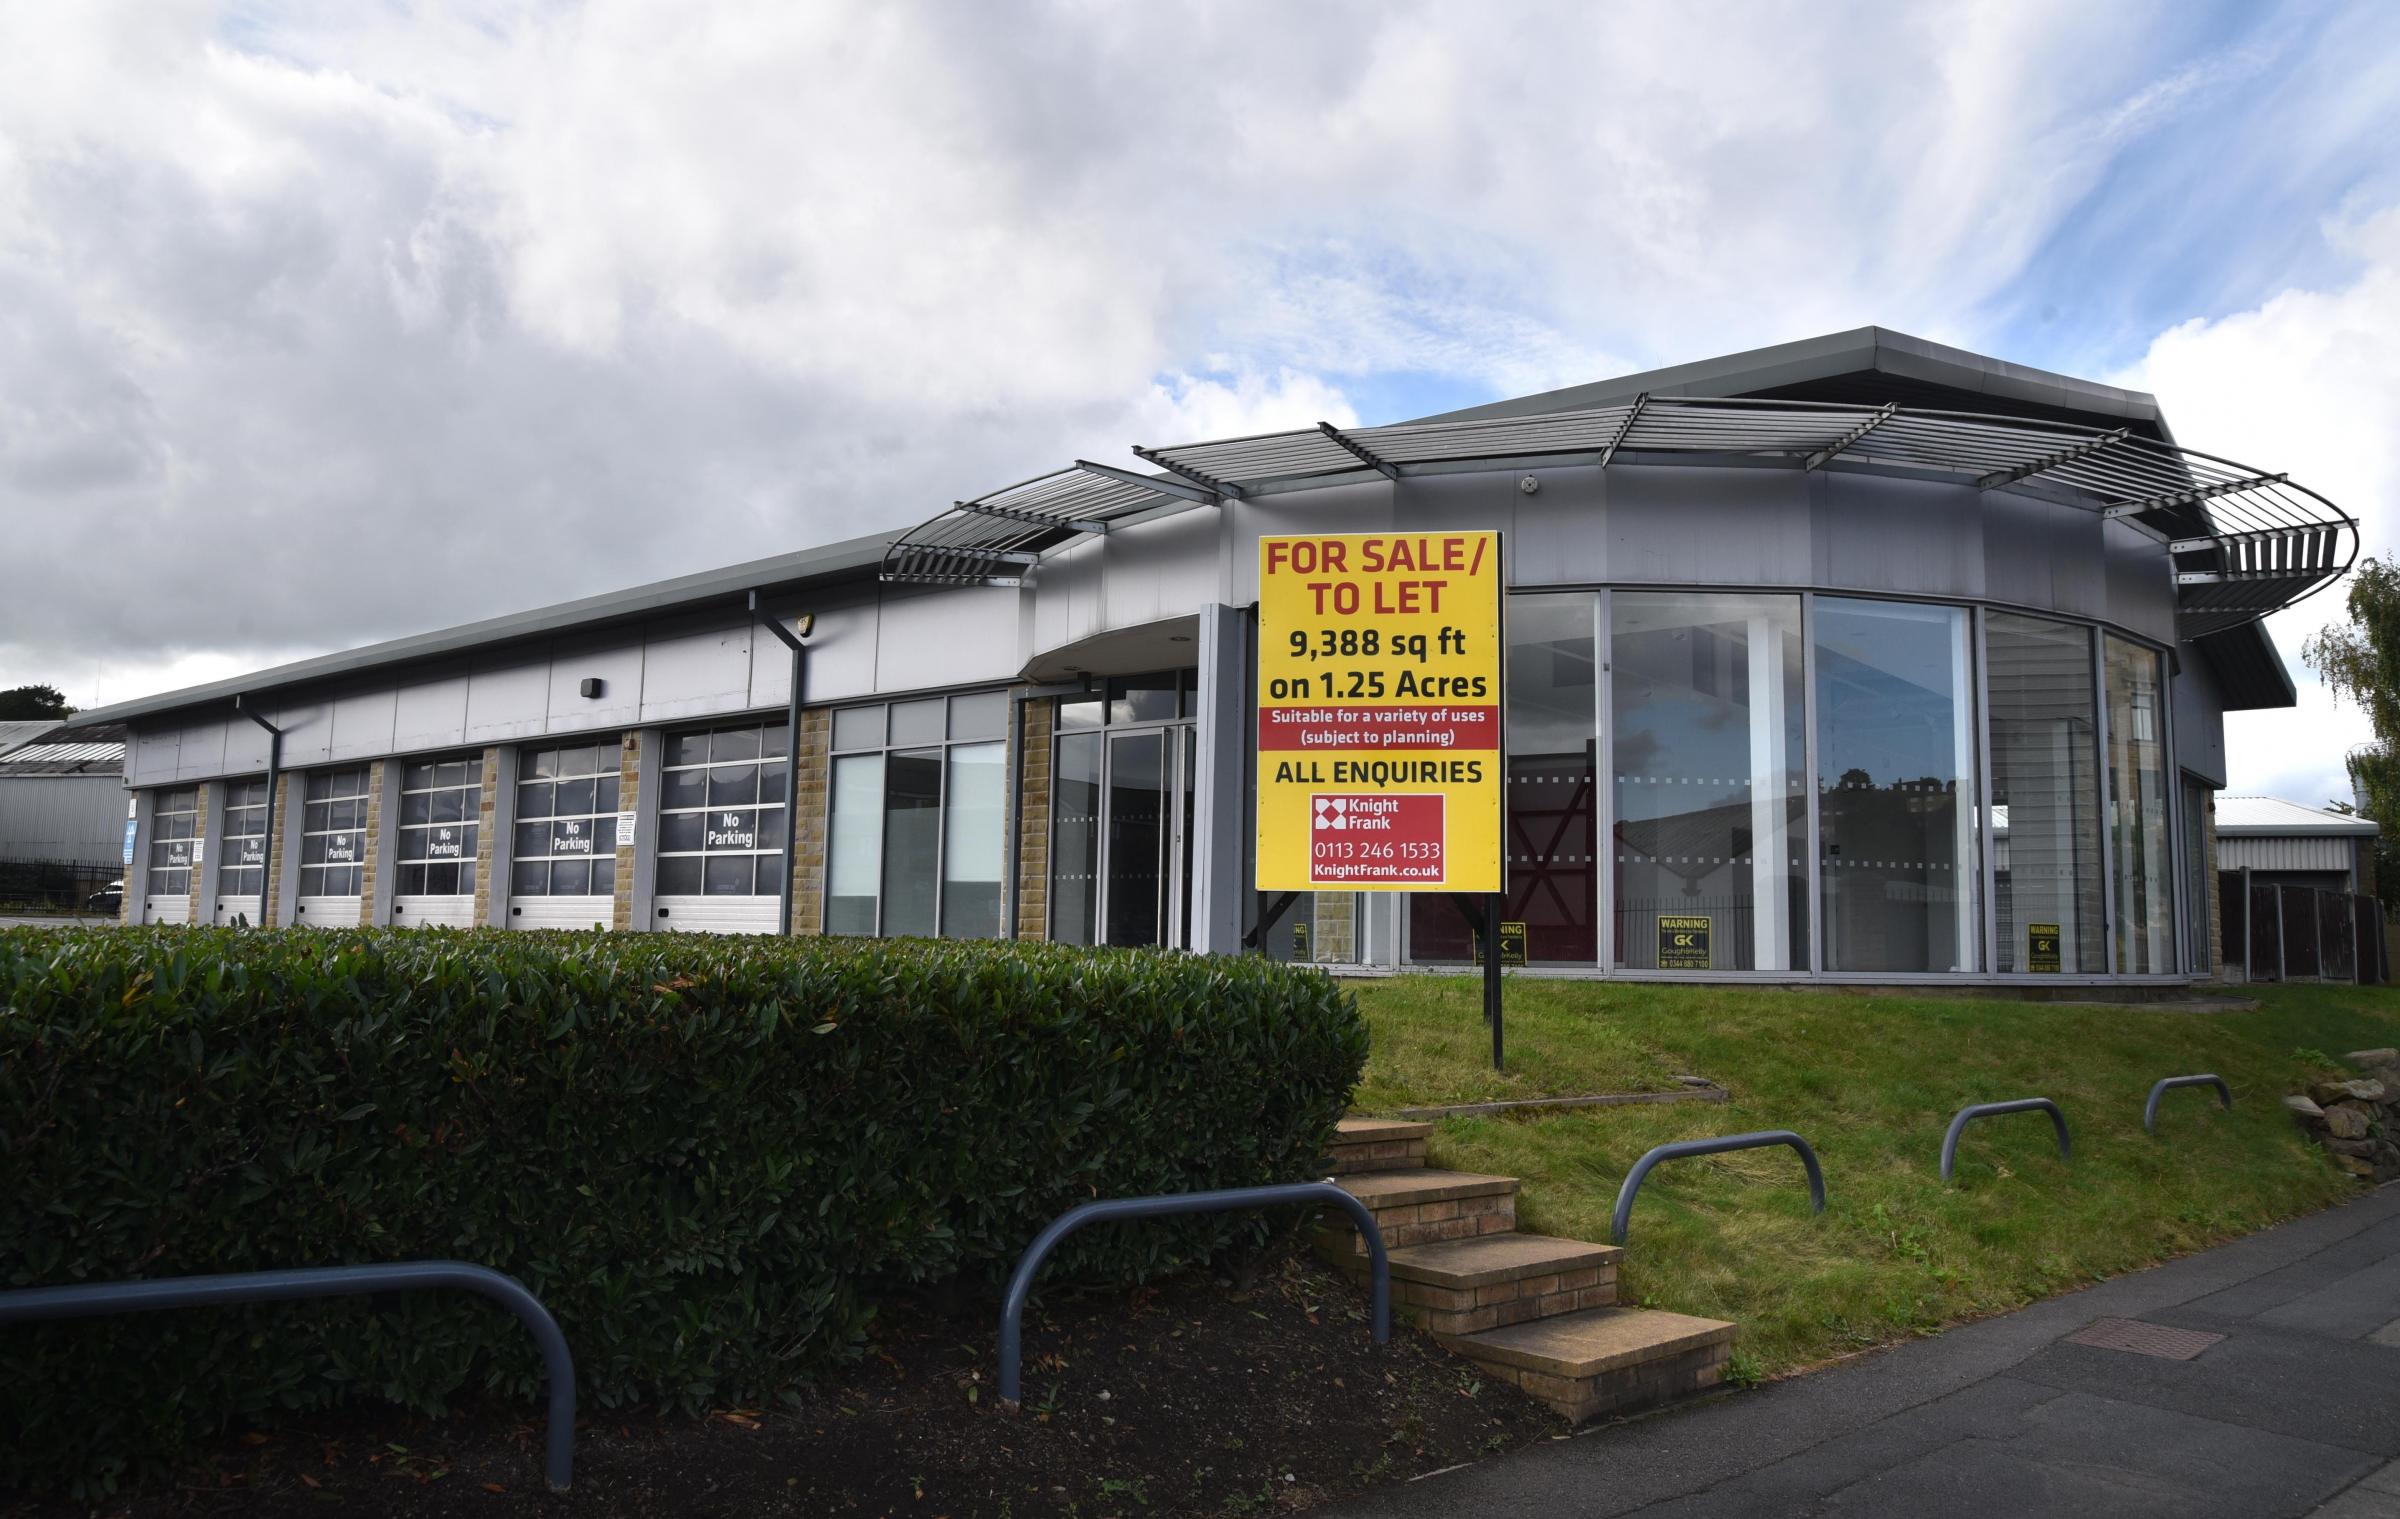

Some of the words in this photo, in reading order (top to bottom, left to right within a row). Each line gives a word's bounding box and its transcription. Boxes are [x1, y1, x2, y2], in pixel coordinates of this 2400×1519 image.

[1267, 541, 1348, 574] FOR
[1362, 538, 1487, 576] SALE/
[1307, 582, 1359, 615] TO
[1374, 581, 1447, 614] LET
[1290, 629, 1380, 662] 9,388
[1391, 634, 1427, 663] sq
[1438, 626, 1466, 655] ft
[1270, 678, 1309, 699] on
[1320, 671, 1385, 698] 1.25
[1395, 670, 1487, 698] Acres
[1272, 709, 1333, 723] Suitable
[1337, 709, 1359, 722] for
[1362, 712, 1371, 722] a
[1375, 709, 1428, 725] variety
[1432, 708, 1447, 722] of
[1451, 711, 1485, 721] uses
[1301, 730, 1360, 746] (subject
[1363, 731, 1379, 744] to
[1383, 729, 1455, 746] planning)
[1275, 761, 1325, 783] ALL
[1334, 761, 1482, 788] ENQUIRIES
[1349, 798, 1399, 816] Knight
[723, 813, 739, 828] No
[1349, 816, 1391, 830] Frank
[440, 828, 451, 840] No
[566, 821, 579, 835] No
[250, 840, 258, 849] No
[337, 835, 346, 846] No
[554, 838, 590, 853] Parking
[708, 830, 753, 848] Parking
[176, 843, 183, 853] No
[328, 848, 353, 861] Parking
[430, 843, 459, 856] Parking
[1315, 842, 1353, 859] 0113
[1359, 842, 1394, 858] 246
[1400, 842, 1440, 859] 1533
[170, 853, 188, 866] Parking
[243, 851, 264, 863] Parking
[1314, 864, 1440, 878] KnightFrank.co.uk
[1661, 919, 1708, 928] WARNING
[1674, 934, 1694, 946] GK
